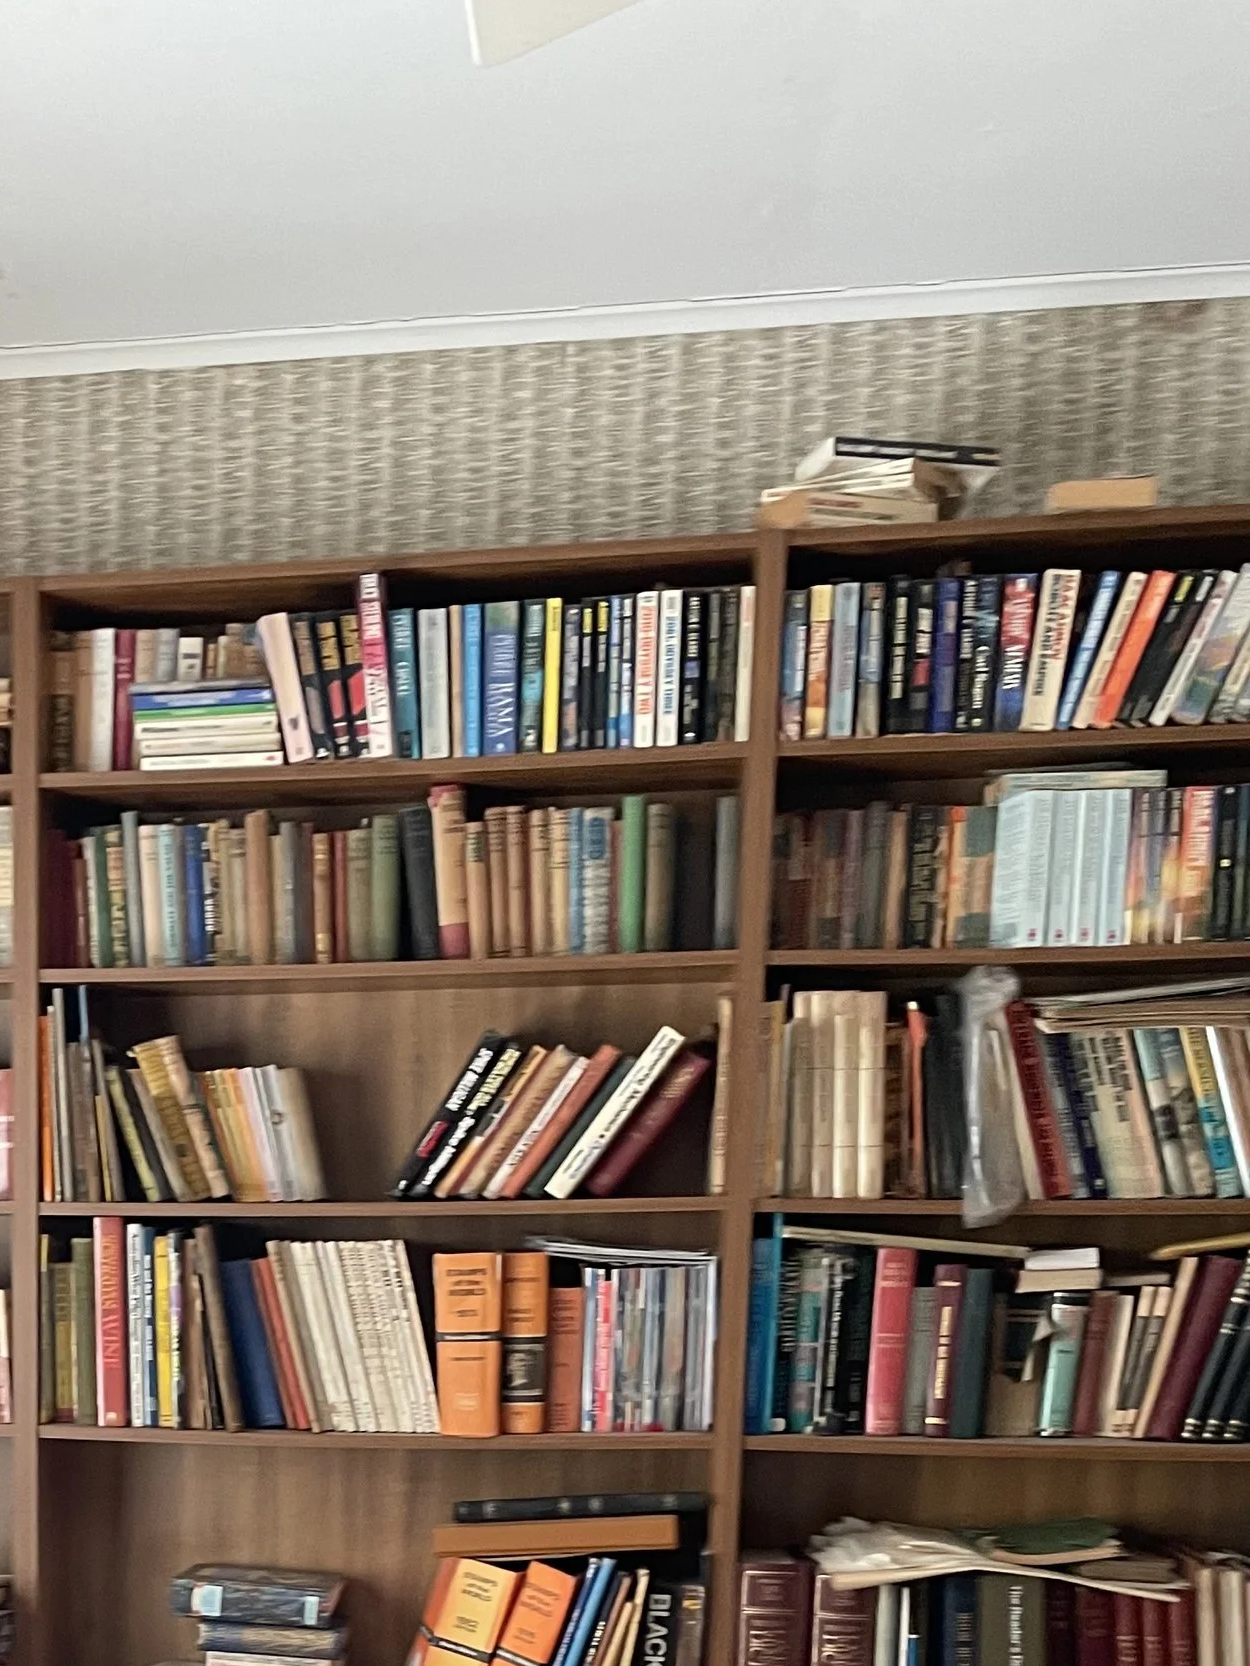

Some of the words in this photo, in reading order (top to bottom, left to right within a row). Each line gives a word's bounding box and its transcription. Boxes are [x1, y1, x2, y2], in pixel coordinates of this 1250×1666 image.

[974, 646, 991, 671] Carl
[636, 690, 652, 715] TWO
[1009, 1586, 1023, 1605] The
